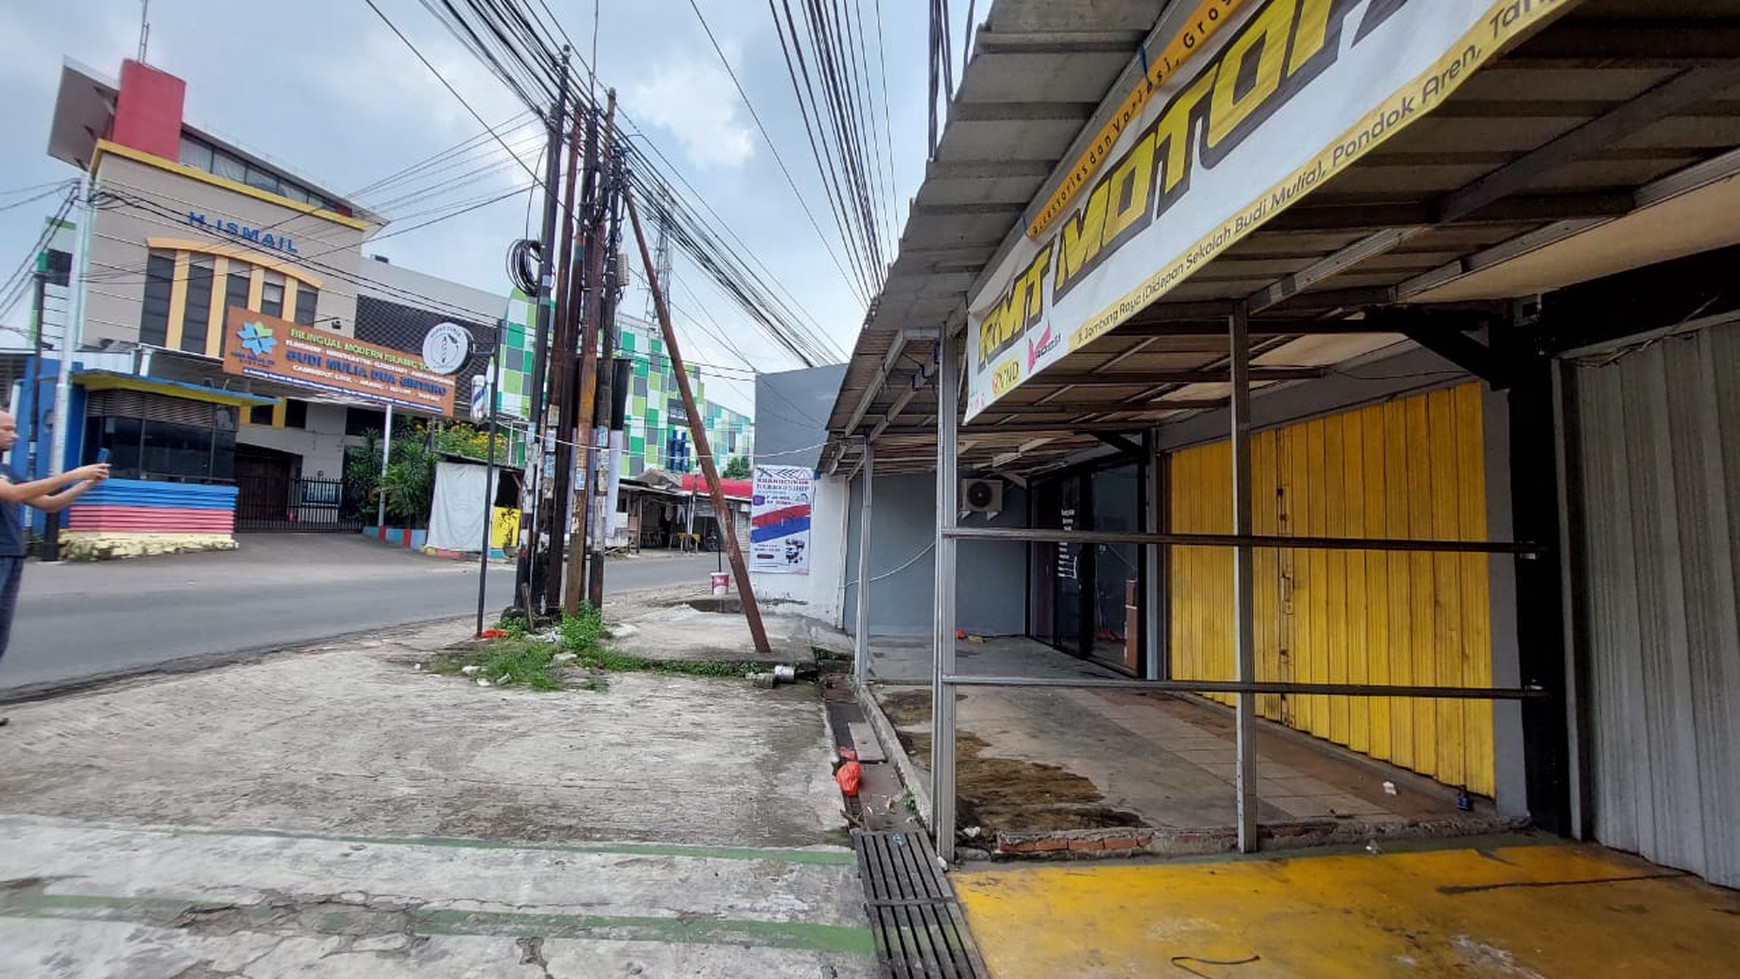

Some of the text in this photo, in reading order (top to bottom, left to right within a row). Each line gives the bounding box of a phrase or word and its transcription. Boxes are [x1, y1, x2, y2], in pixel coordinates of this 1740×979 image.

[1089, 134, 1112, 164] dan
[1186, 226, 1231, 270] Sekolah
[1233, 199, 1268, 235] Budi
[1270, 161, 1326, 211] Mulia),
[1332, 95, 1415, 167] Pondok
[1421, 43, 1483, 105] Aren,
